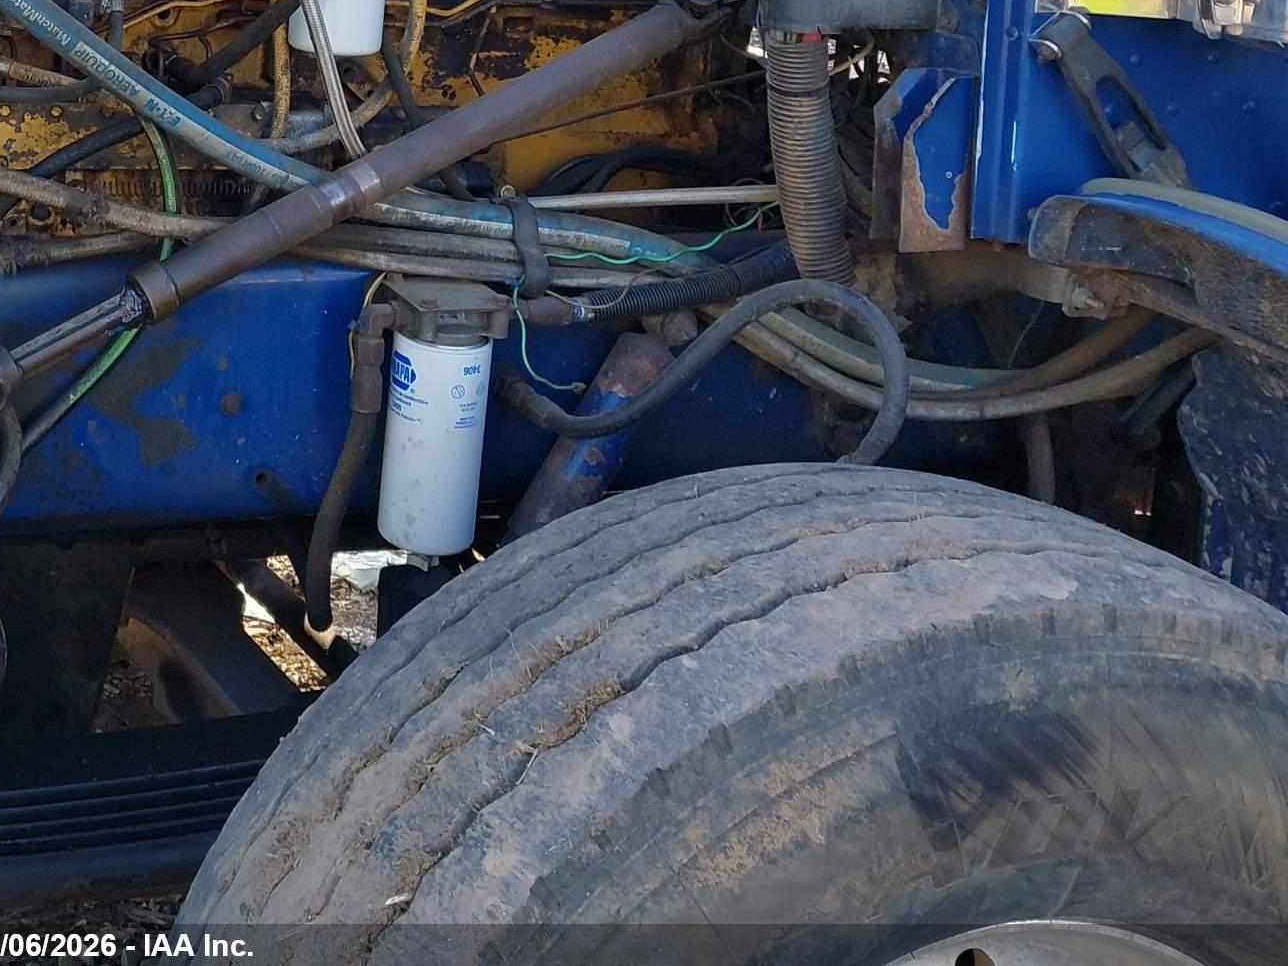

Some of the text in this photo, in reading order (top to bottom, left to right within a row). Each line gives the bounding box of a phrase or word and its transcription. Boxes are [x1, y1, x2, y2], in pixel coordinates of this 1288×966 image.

[73, 46, 140, 99] AEROQUIP
[392, 358, 410, 384] NAPA
[463, 365, 482, 376] 3406
